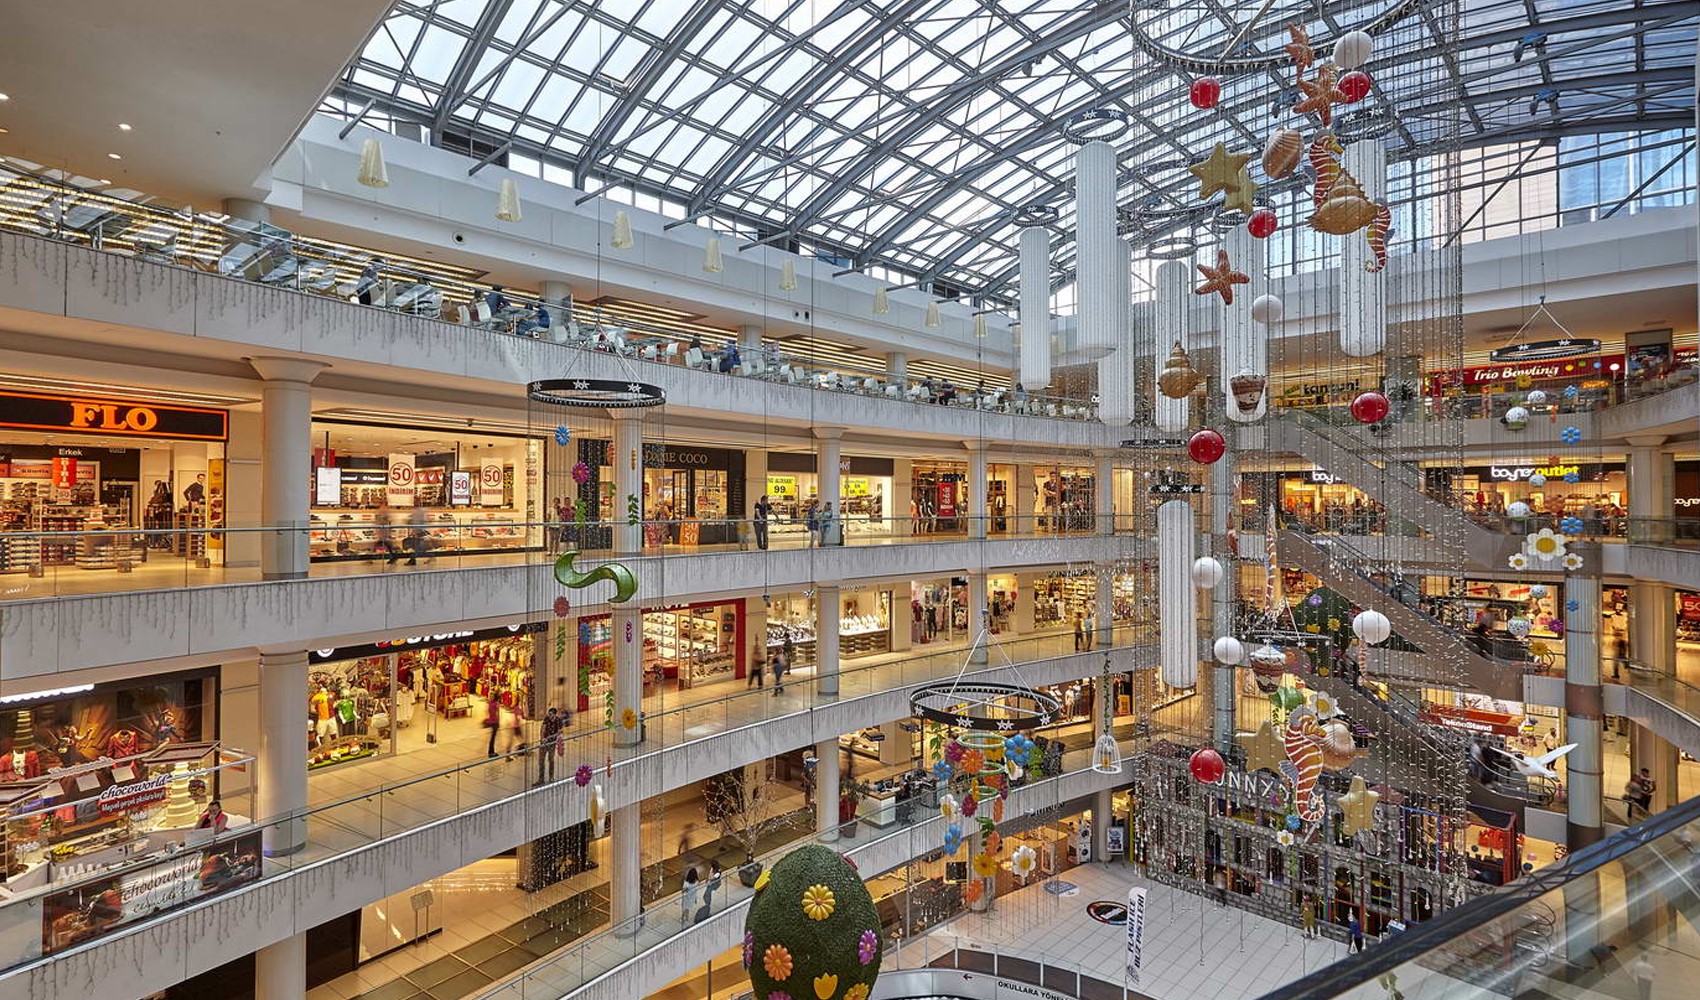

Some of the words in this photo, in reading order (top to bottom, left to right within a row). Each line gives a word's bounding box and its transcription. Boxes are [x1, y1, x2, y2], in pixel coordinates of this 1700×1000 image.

[1474, 370, 1499, 381] Trio
[1502, 365, 1559, 379] Bowling
[70, 402, 157, 431] FLO
[59, 448, 83, 456] Erkek
[679, 453, 708, 464] COCO
[391, 467, 412, 482] 50
[483, 471, 500, 482] 50
[1491, 466, 1535, 481] boyner
[1535, 466, 1579, 477] outlet
[455, 480, 468, 490] 50
[1441, 718, 1493, 731] TeknoStand
[100, 774, 170, 799] chocoworld
[123, 852, 203, 901] chocoworld
[998, 981, 1039, 997] OKULLARA
